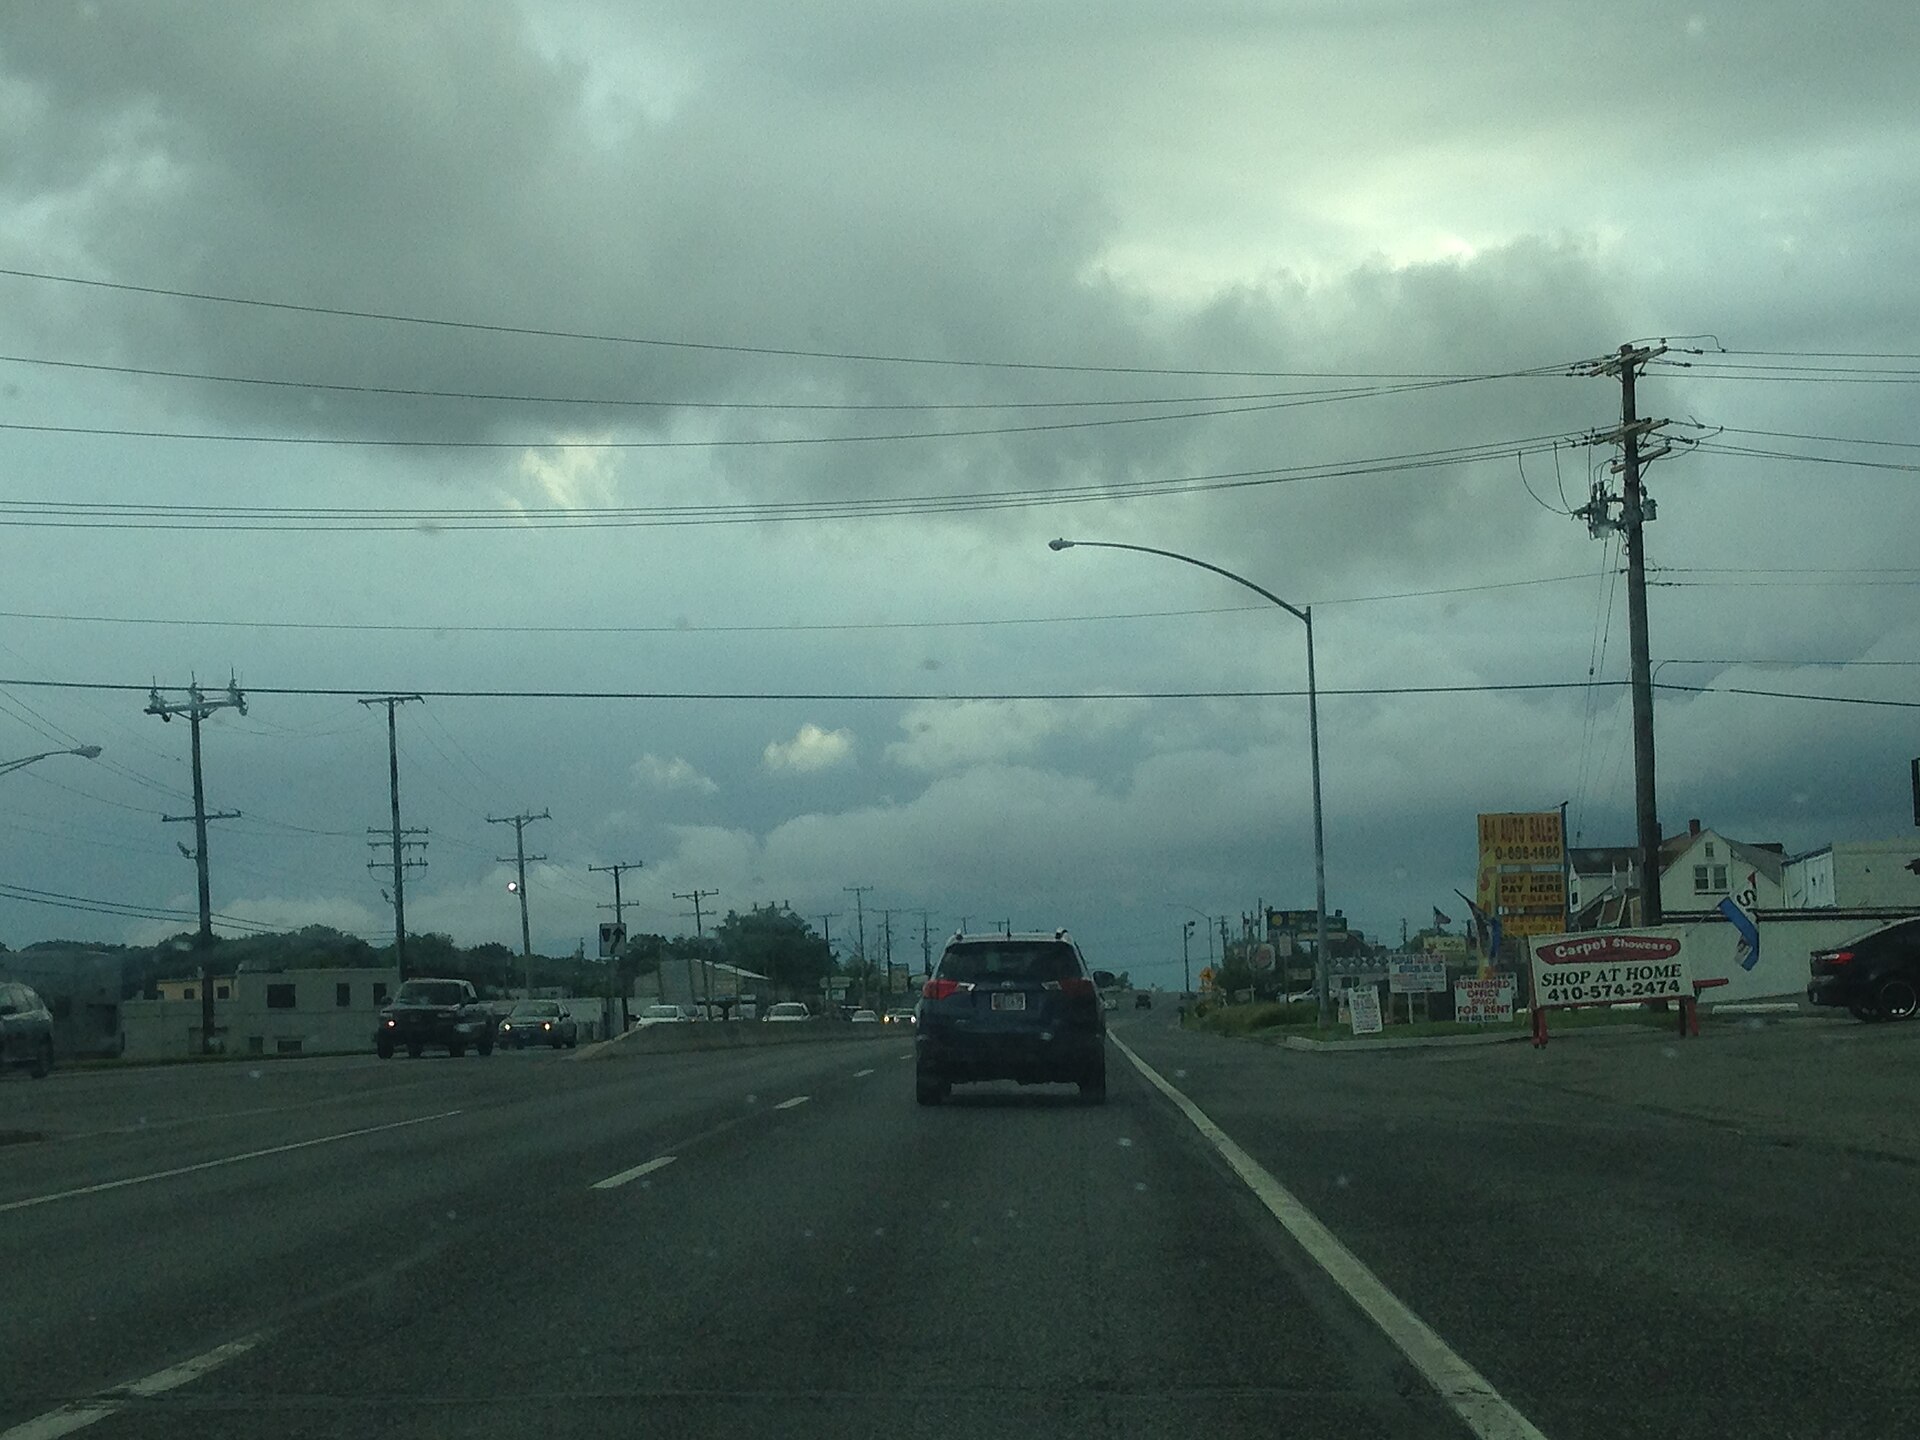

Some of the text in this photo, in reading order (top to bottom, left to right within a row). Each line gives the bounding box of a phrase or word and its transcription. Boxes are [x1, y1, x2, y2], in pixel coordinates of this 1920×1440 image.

[1530, 816, 1559, 843] SALES
[1531, 874, 1562, 883] HERE
[1501, 884, 1562, 894] PAY HERE
[1554, 938, 1673, 958] Carpet Showcase
[1541, 963, 1682, 987] SHOP AT HOME
[1455, 980, 1510, 990] FURNISHED
[1548, 979, 1680, 1001] 410-574-2474
[1467, 989, 1500, 998] OFFICE
[1457, 1004, 1511, 1015] FOR RENT
